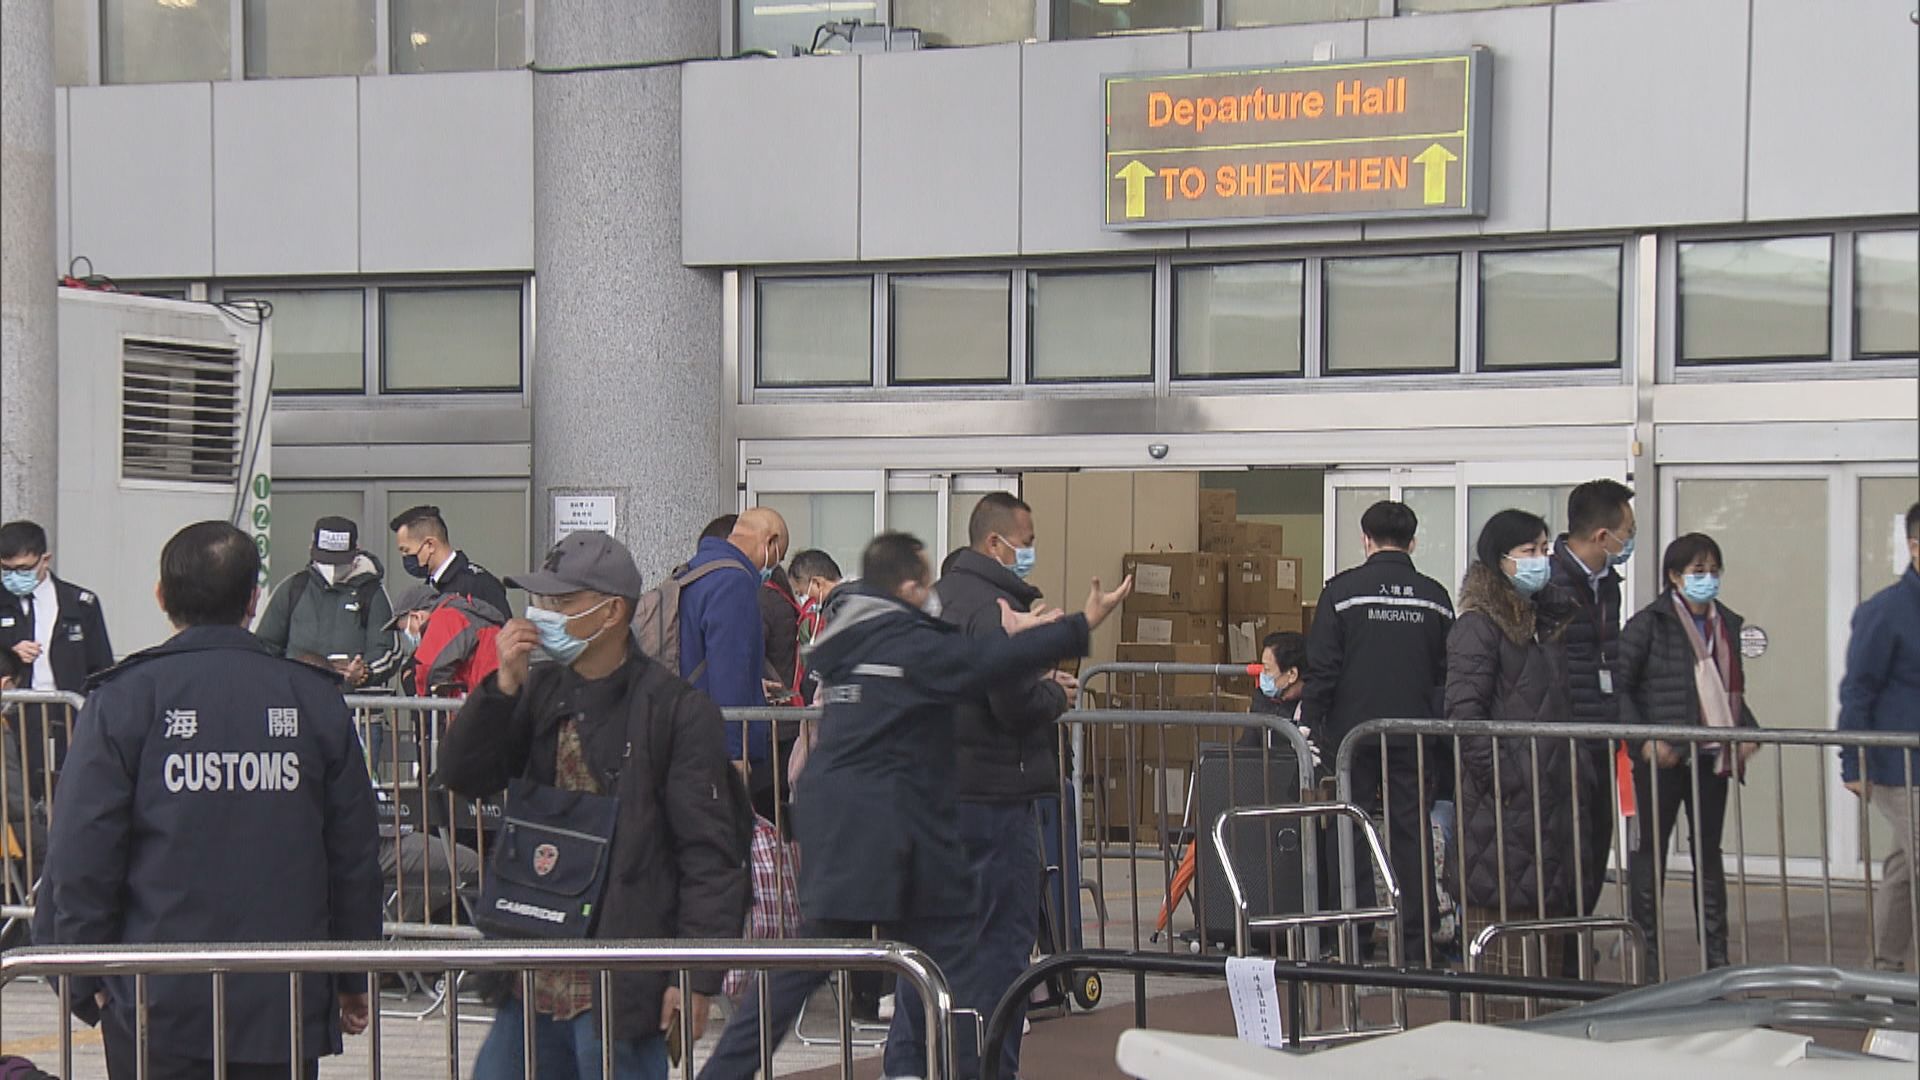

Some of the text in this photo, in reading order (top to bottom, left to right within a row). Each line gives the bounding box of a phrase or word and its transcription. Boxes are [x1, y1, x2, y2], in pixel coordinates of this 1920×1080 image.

[1148, 77, 1407, 132] Departure Hall
[1159, 157, 1409, 201] TO SHENZHEN
[1368, 608, 1424, 623] IMMIGRATION
[164, 751, 300, 793] CUSTOMS
